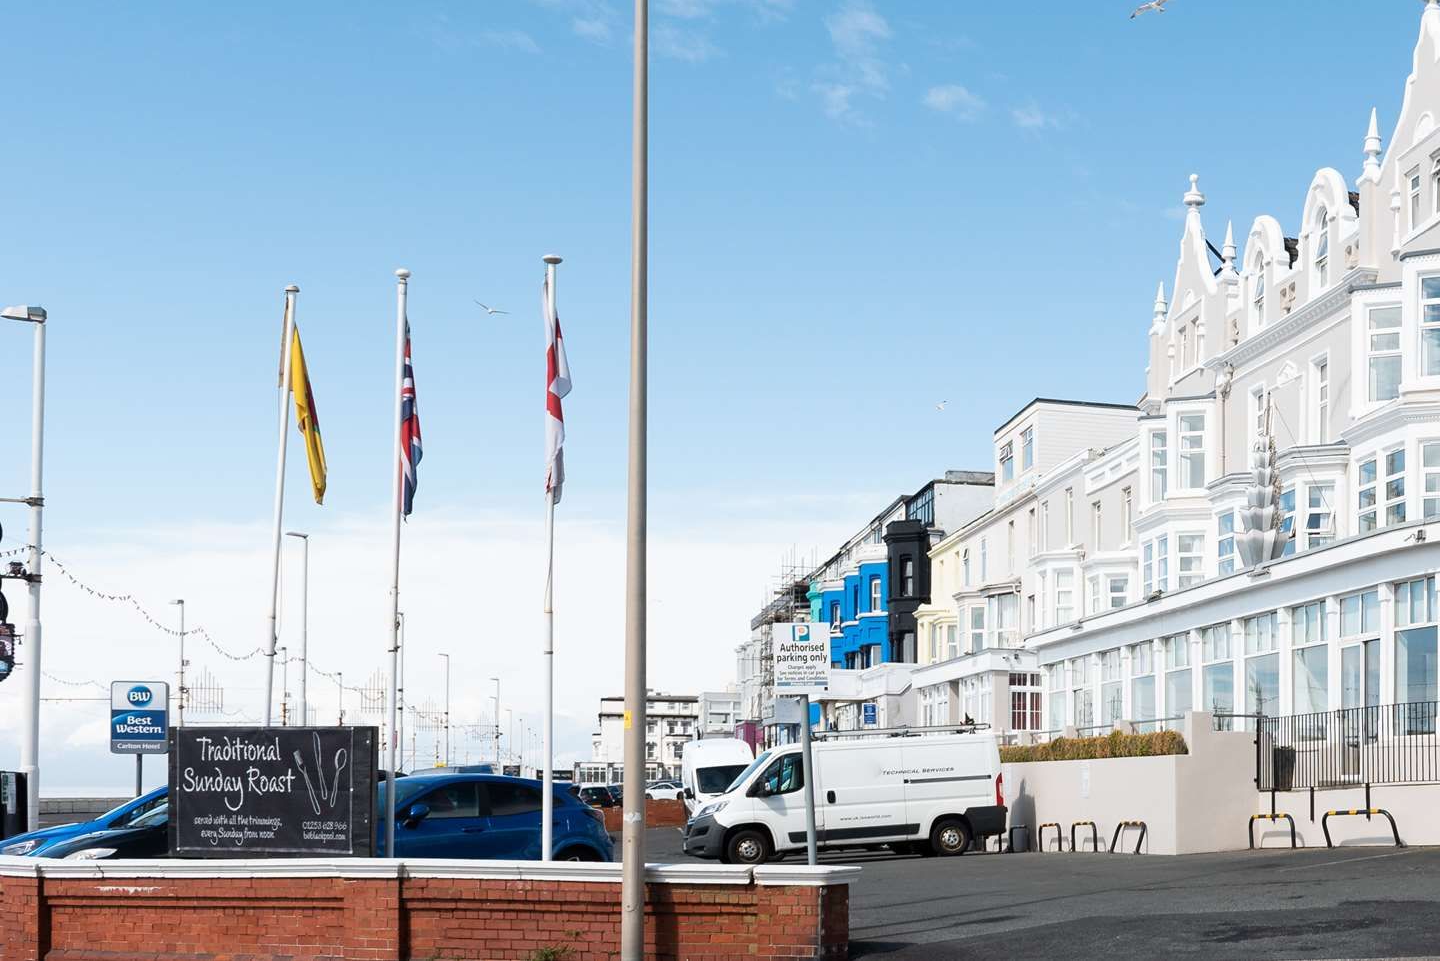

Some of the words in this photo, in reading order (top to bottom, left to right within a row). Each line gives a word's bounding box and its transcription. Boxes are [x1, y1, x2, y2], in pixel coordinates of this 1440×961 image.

[780, 643, 824, 652] Authorised
[777, 652, 808, 664] parking
[810, 652, 828, 663] only
[129, 691, 150, 702] BW
[127, 715, 152, 725] Best
[116, 724, 162, 734] Western
[196, 736, 282, 761] Traditional
[183, 767, 244, 811] Sunday
[246, 766, 296, 796] Roast
[193, 814, 213, 825] served
[213, 815, 228, 825] with
[237, 815, 248, 825] the
[200, 829, 218, 845] every
[218, 827, 244, 845] Sunday
[243, 827, 258, 839] from
